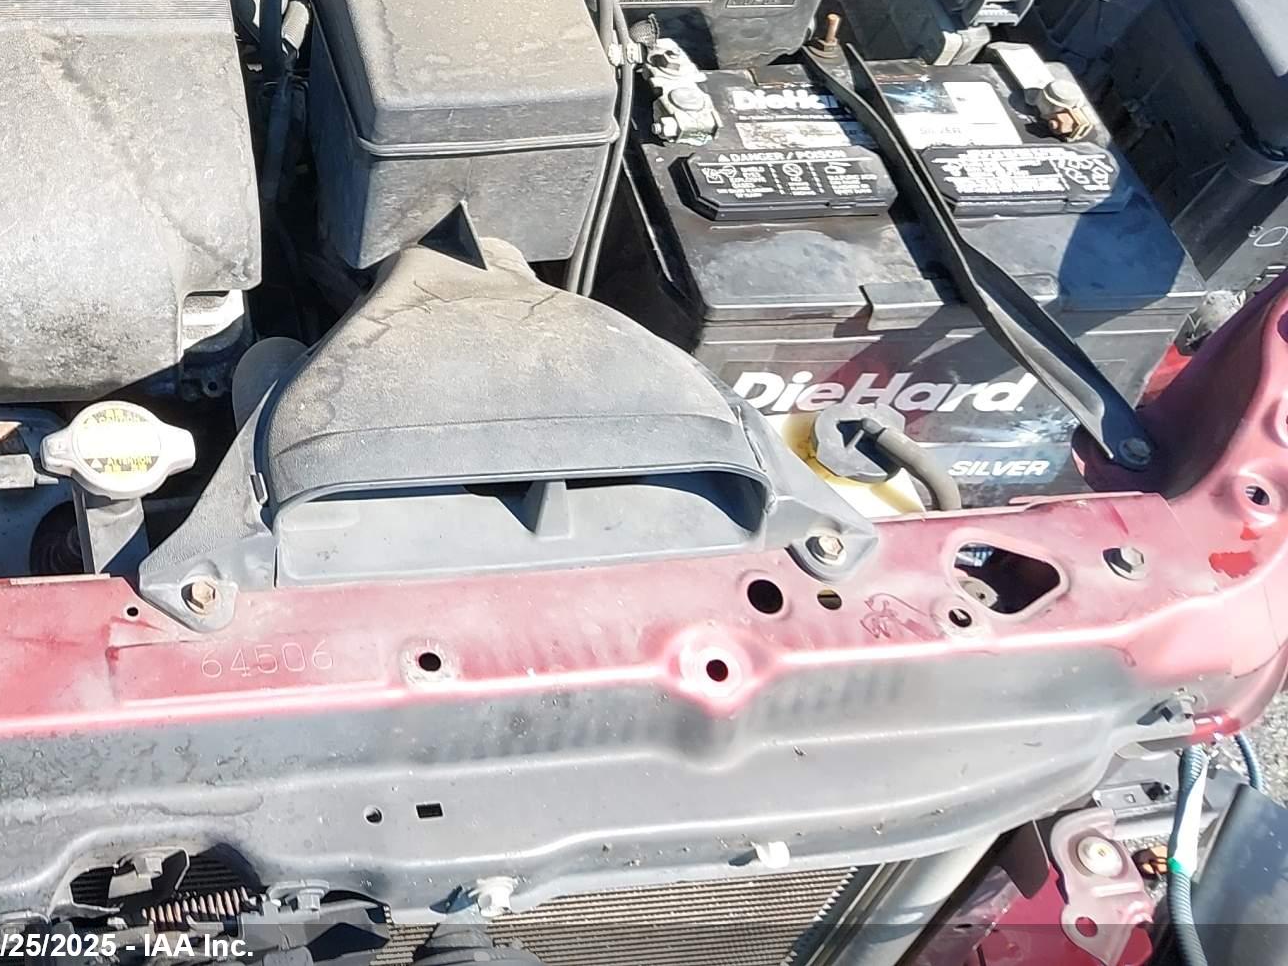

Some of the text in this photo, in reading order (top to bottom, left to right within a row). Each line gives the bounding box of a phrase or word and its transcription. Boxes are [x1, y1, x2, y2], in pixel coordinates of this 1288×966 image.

[730, 152, 784, 163] DANGER
[796, 149, 849, 160] POISON
[732, 370, 1038, 413] DieHard
[948, 459, 1050, 477] SILVER
[201, 639, 334, 678] 64506
